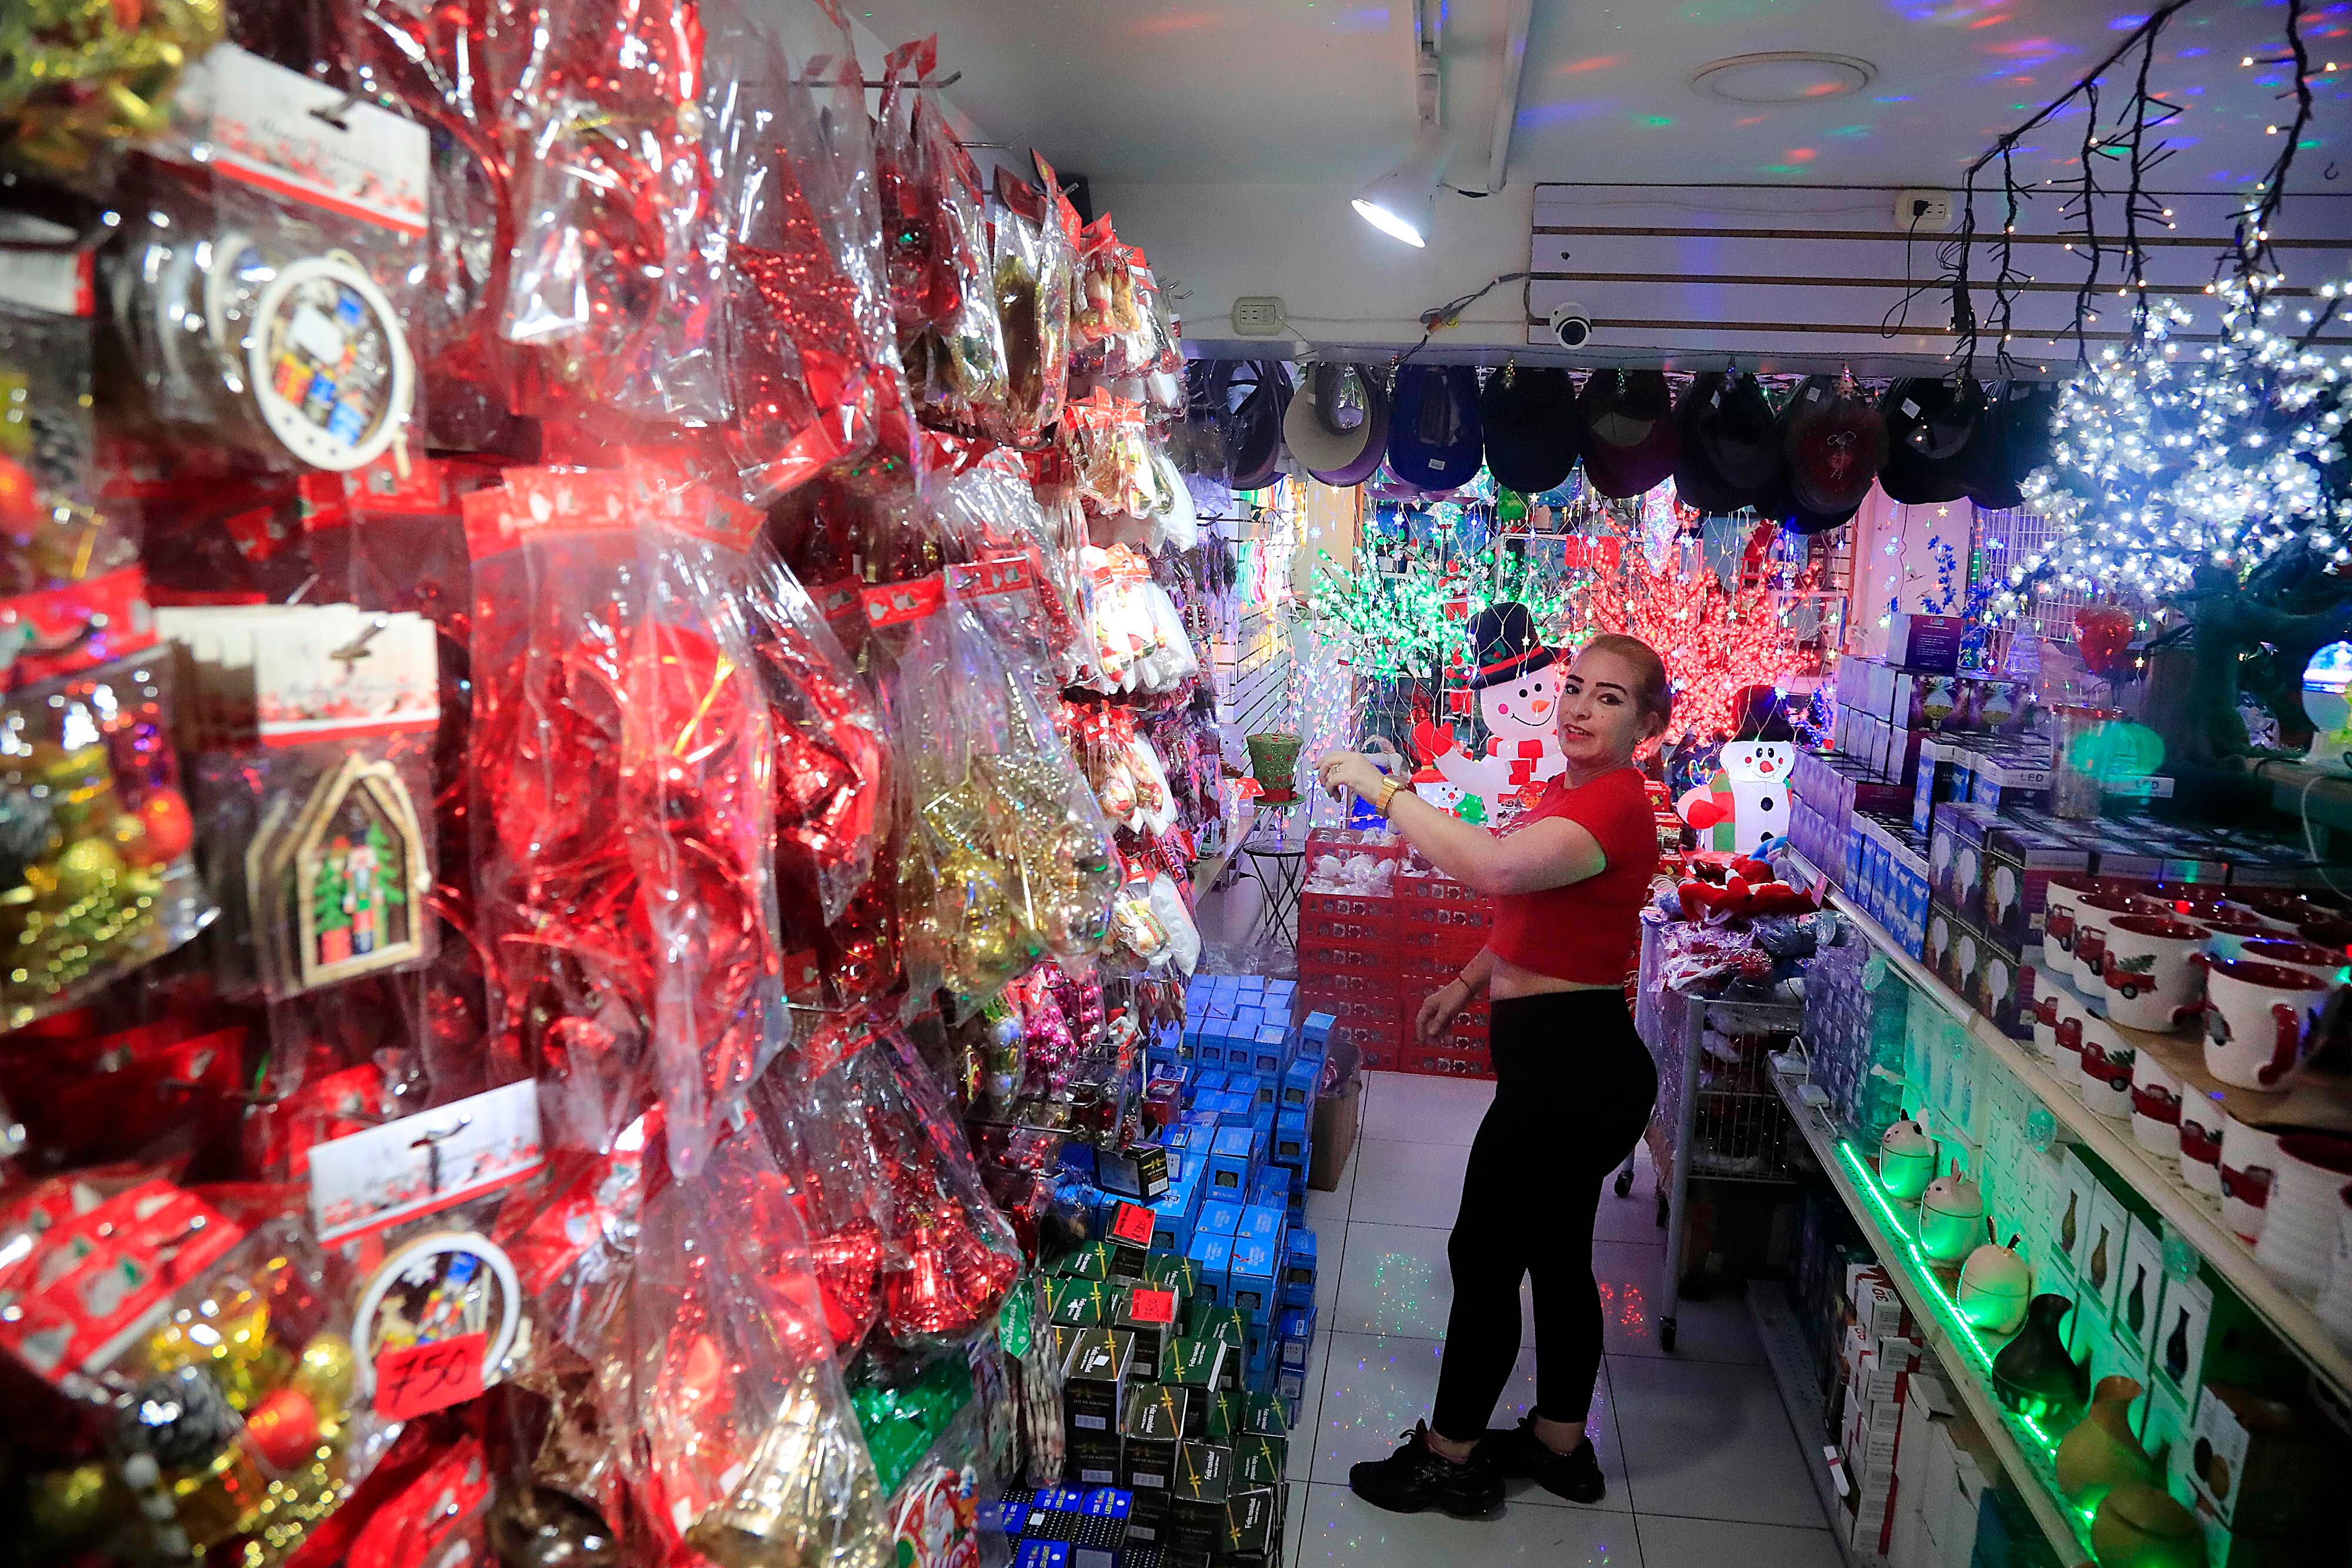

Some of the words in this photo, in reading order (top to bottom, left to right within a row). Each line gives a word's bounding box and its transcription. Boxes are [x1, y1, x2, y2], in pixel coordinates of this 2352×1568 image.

[2020, 773, 2044, 782] LED
[1078, 1299, 1087, 1308] Feliz
[1092, 1347, 1100, 1358] Feliz
[1085, 1356, 1094, 1373] navidad
[389, 1349, 467, 1409] 750
[1107, 1492, 1116, 1505] LIGHT
